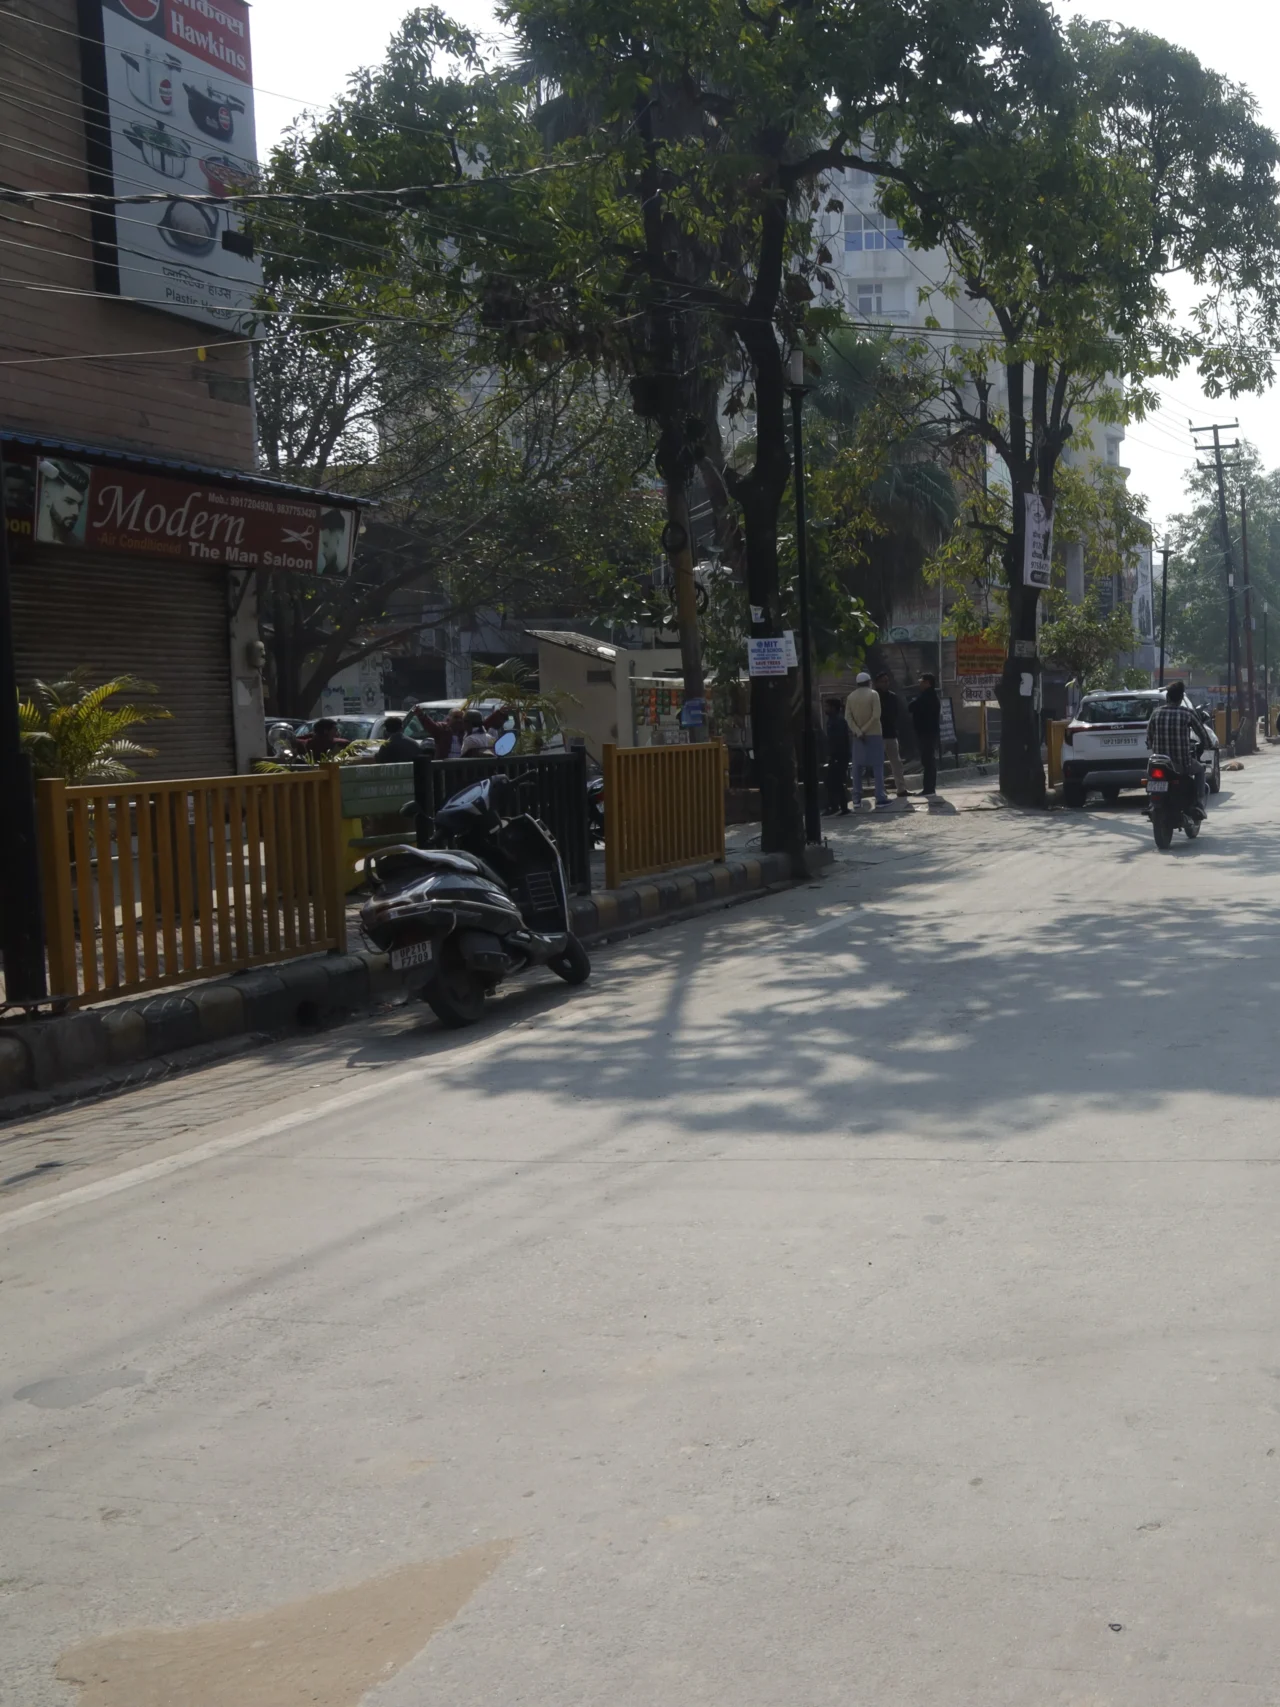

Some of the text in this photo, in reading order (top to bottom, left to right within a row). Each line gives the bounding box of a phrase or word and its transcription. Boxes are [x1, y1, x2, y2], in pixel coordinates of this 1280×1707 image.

[171, 9, 246, 71] Hawkins
[165, 287, 199, 305] Plastic
[92, 485, 245, 545] Modern
[188, 541, 313, 570] The Man Saloon
